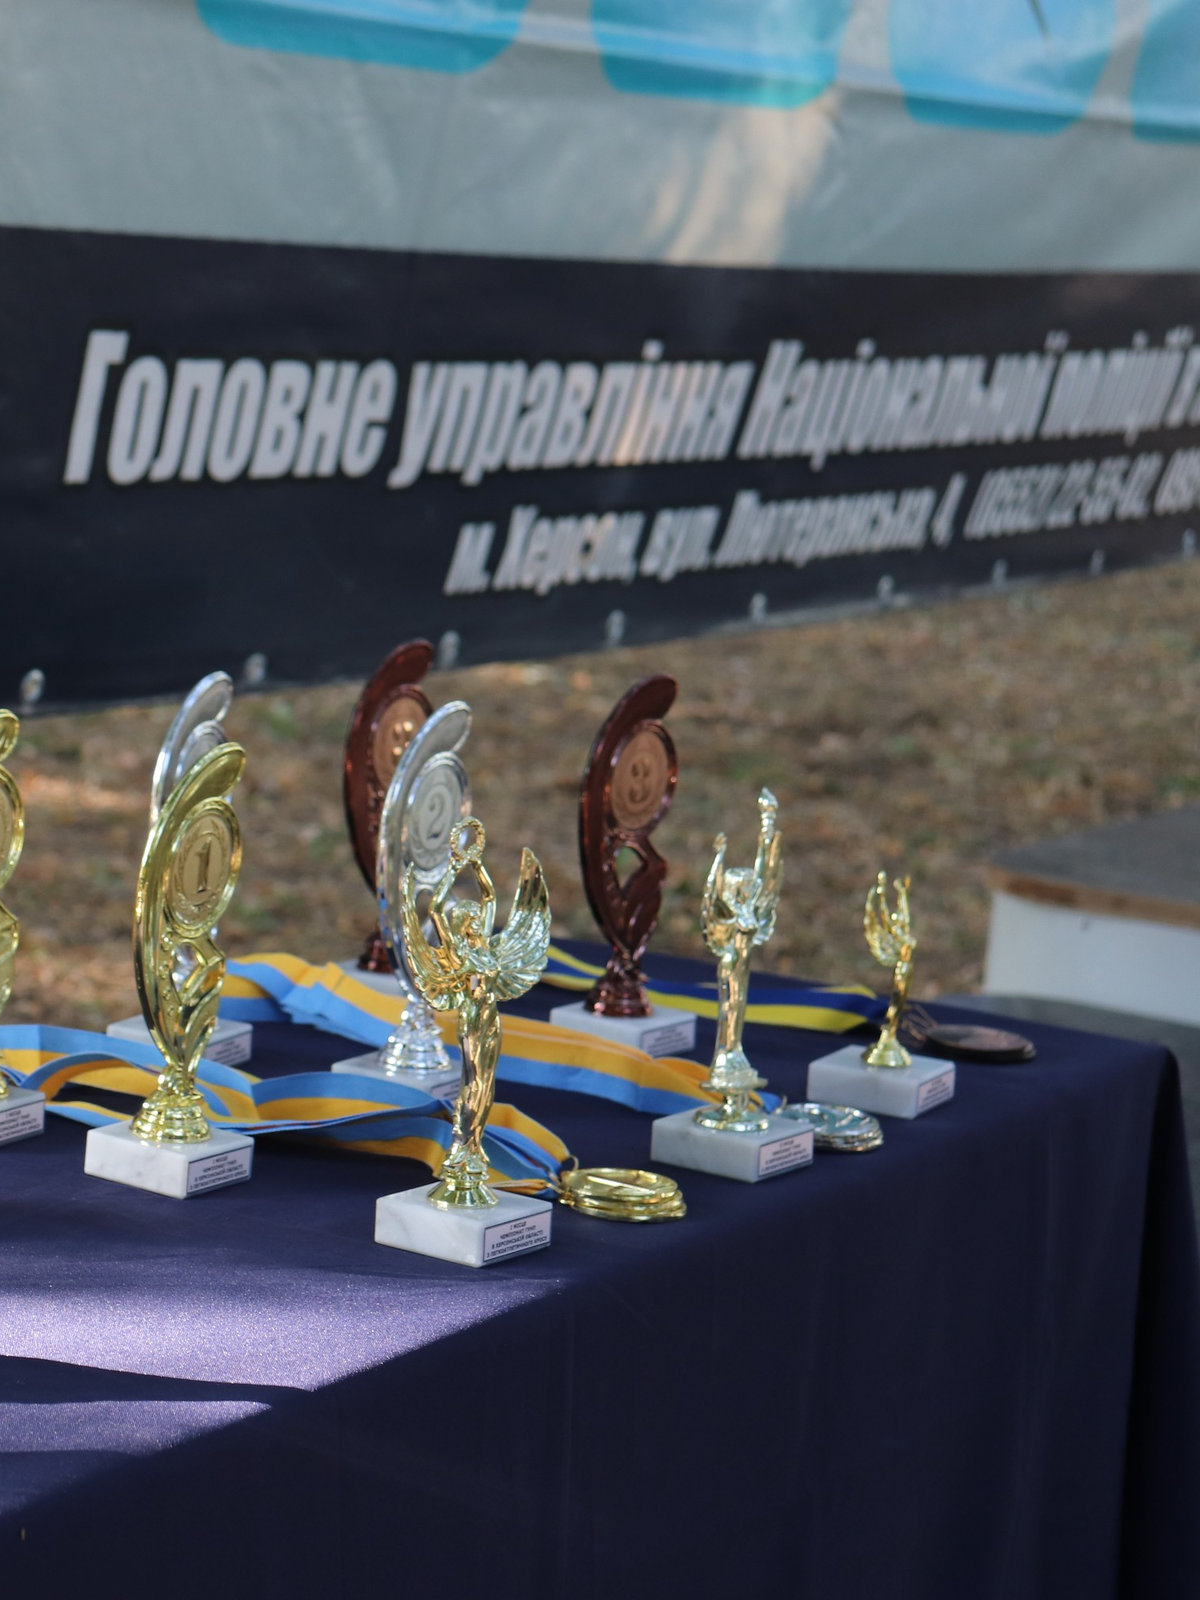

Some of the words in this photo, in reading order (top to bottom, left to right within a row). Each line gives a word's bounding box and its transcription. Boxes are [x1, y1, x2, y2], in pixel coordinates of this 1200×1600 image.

[63, 329, 398, 485] Головне
[386, 339, 753, 489] управління
[427, 793, 446, 840] 2
[197, 839, 212, 894] 1
